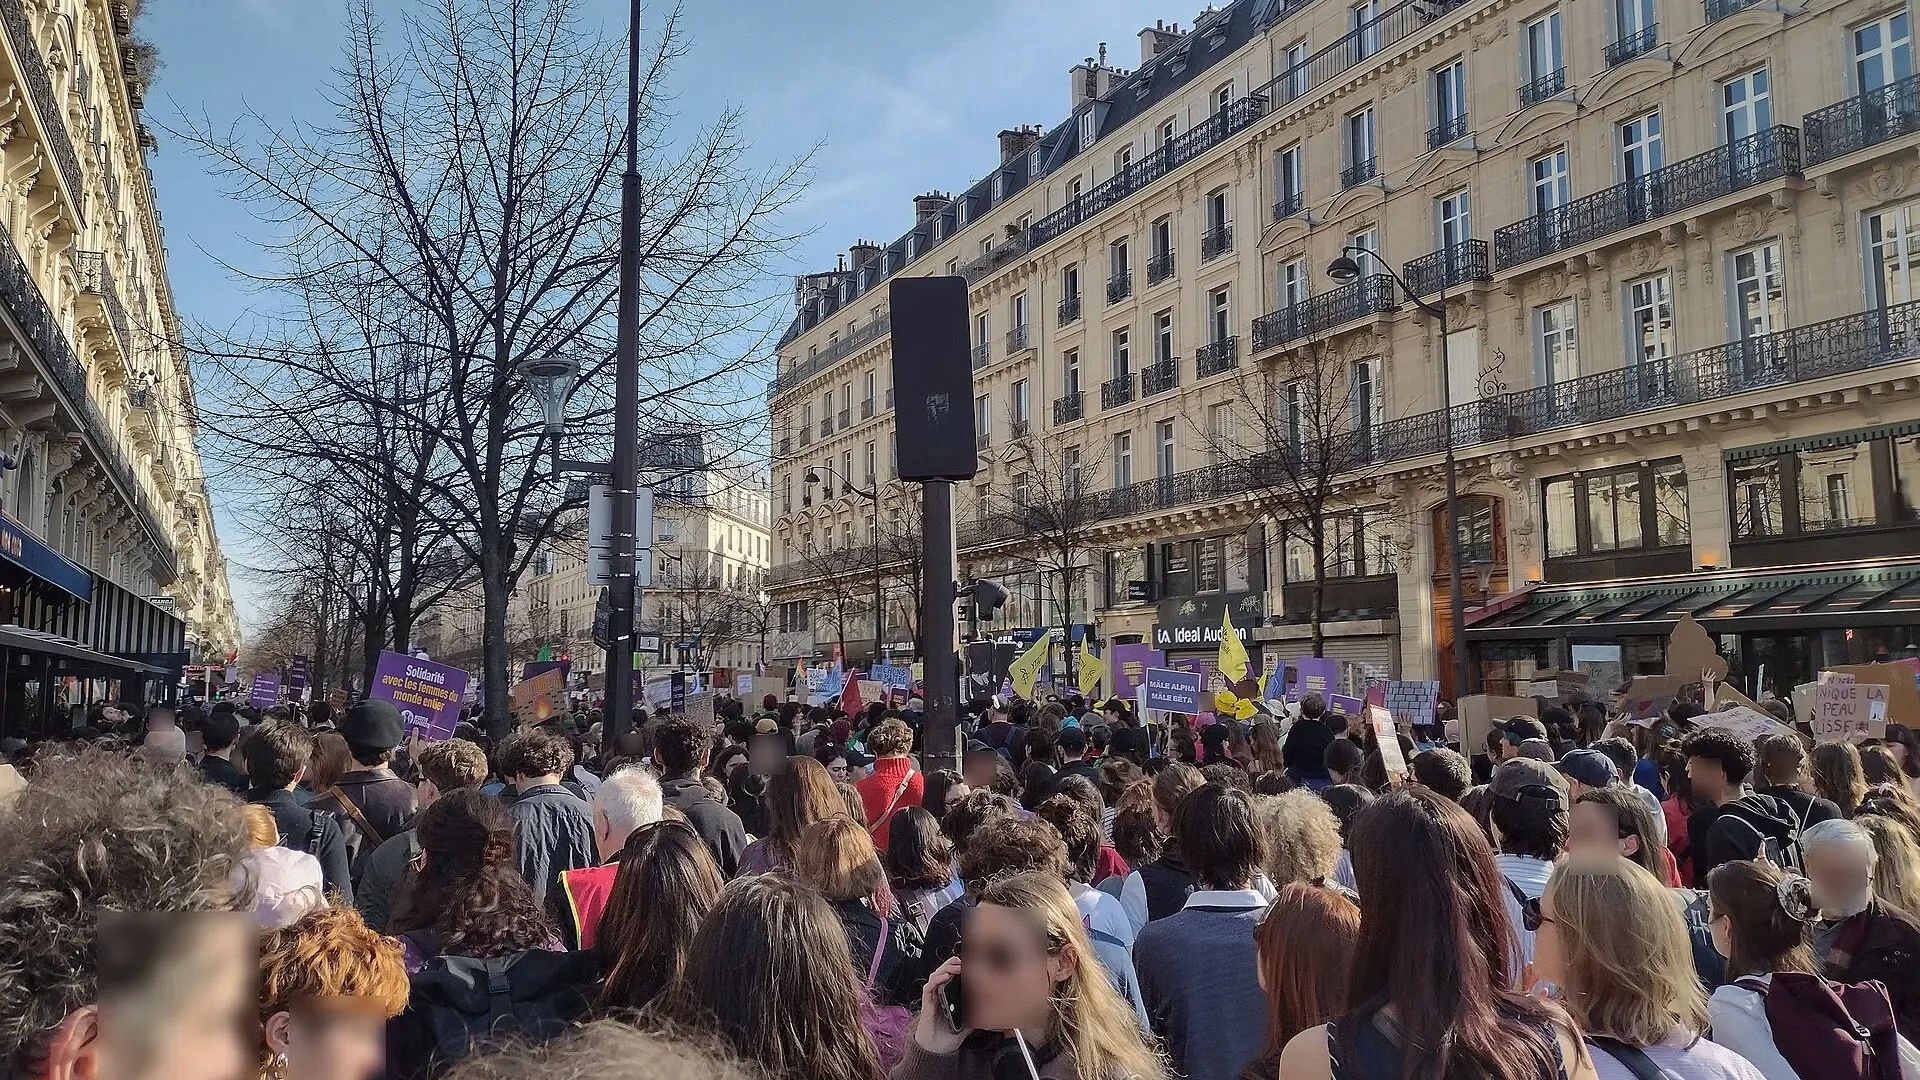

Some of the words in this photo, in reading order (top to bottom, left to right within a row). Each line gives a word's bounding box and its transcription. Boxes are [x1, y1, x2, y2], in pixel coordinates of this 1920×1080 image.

[1174, 626, 1201, 643] Ideal
[1203, 626, 1247, 642] Audon
[405, 664, 445, 684] Solidarité
[382, 674, 404, 687] avec
[404, 677, 418, 690] les
[418, 681, 449, 700] femmes
[448, 690, 459, 703] du
[1149, 680, 1170, 690] MÂLE
[1171, 682, 1196, 692] ALPHA
[393, 690, 423, 705] monde
[422, 697, 446, 712] entier
[1151, 691, 1172, 702] MÂLE
[1172, 694, 1193, 704] BÊTA
[1866, 688, 1884, 700] LA
[1823, 702, 1857, 716] PEAU
